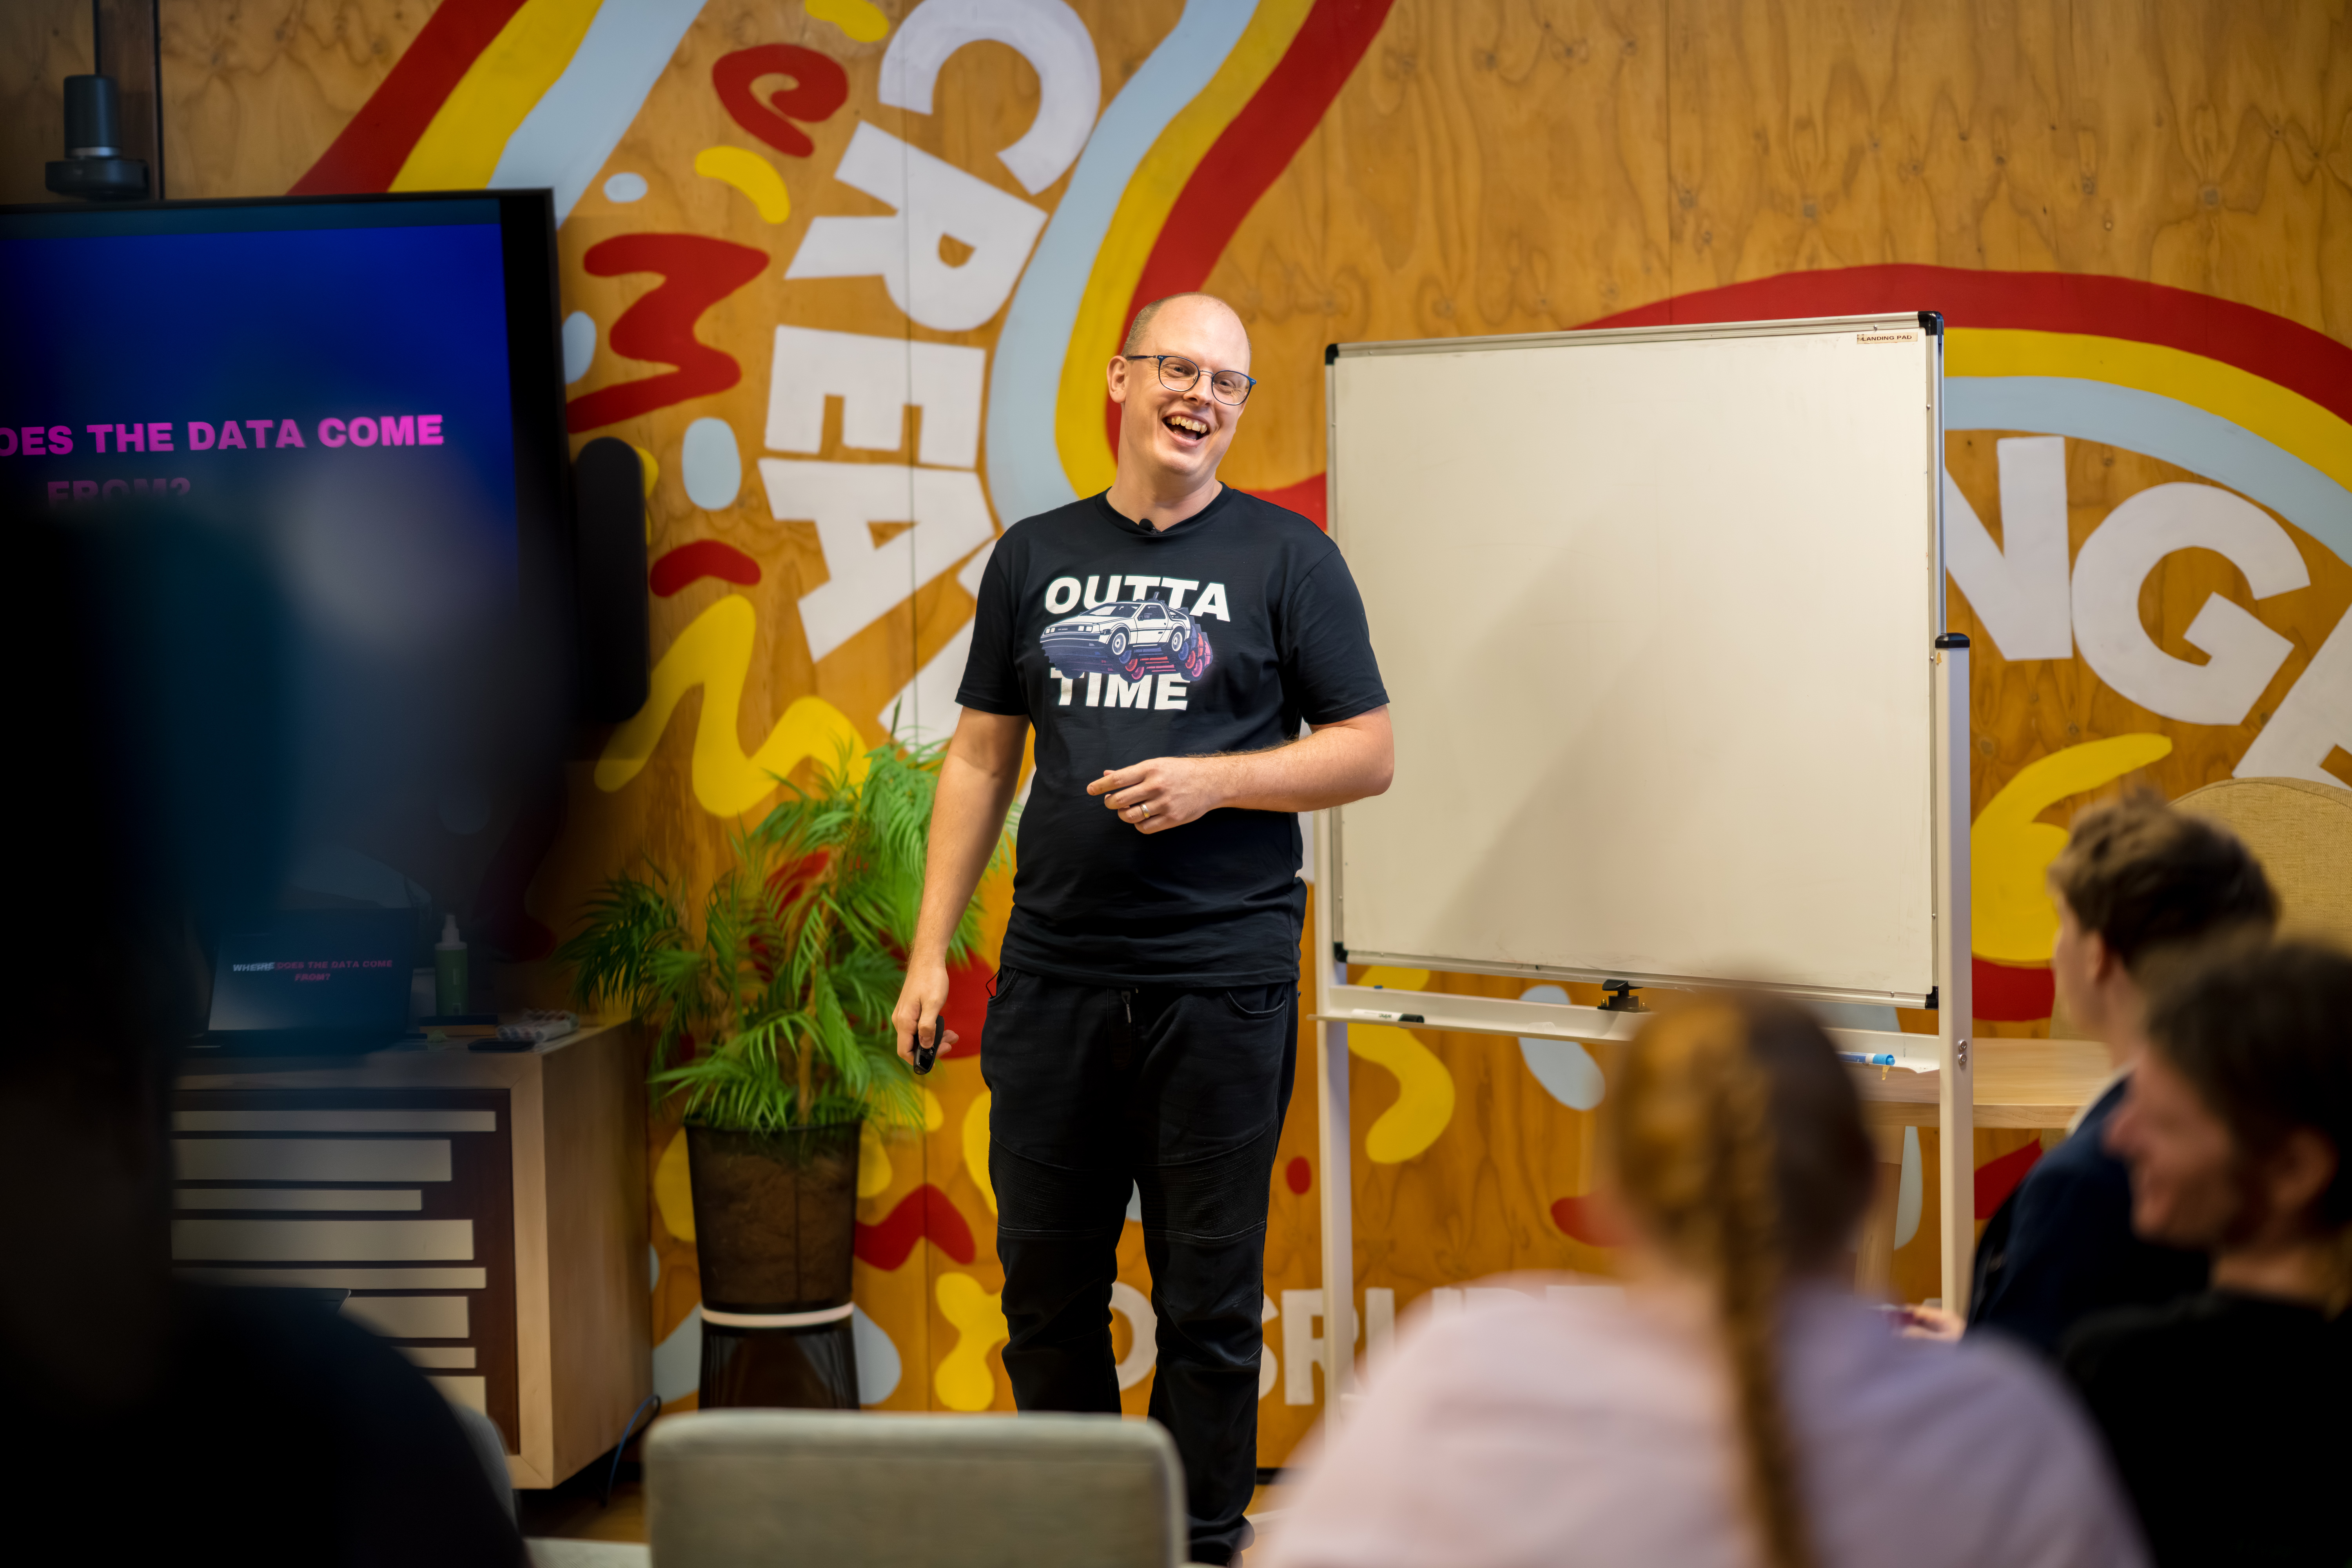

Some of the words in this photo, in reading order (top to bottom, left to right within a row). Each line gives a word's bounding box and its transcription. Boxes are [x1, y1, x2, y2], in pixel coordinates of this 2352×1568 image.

[87, 423, 174, 453] THE
[188, 419, 307, 450] DATA
[318, 414, 444, 448] COME
[1045, 575, 1230, 622] OUTTA
[1050, 667, 1191, 711] TIME
[294, 973, 331, 981] FROM?
[363, 960, 392, 968] COME
